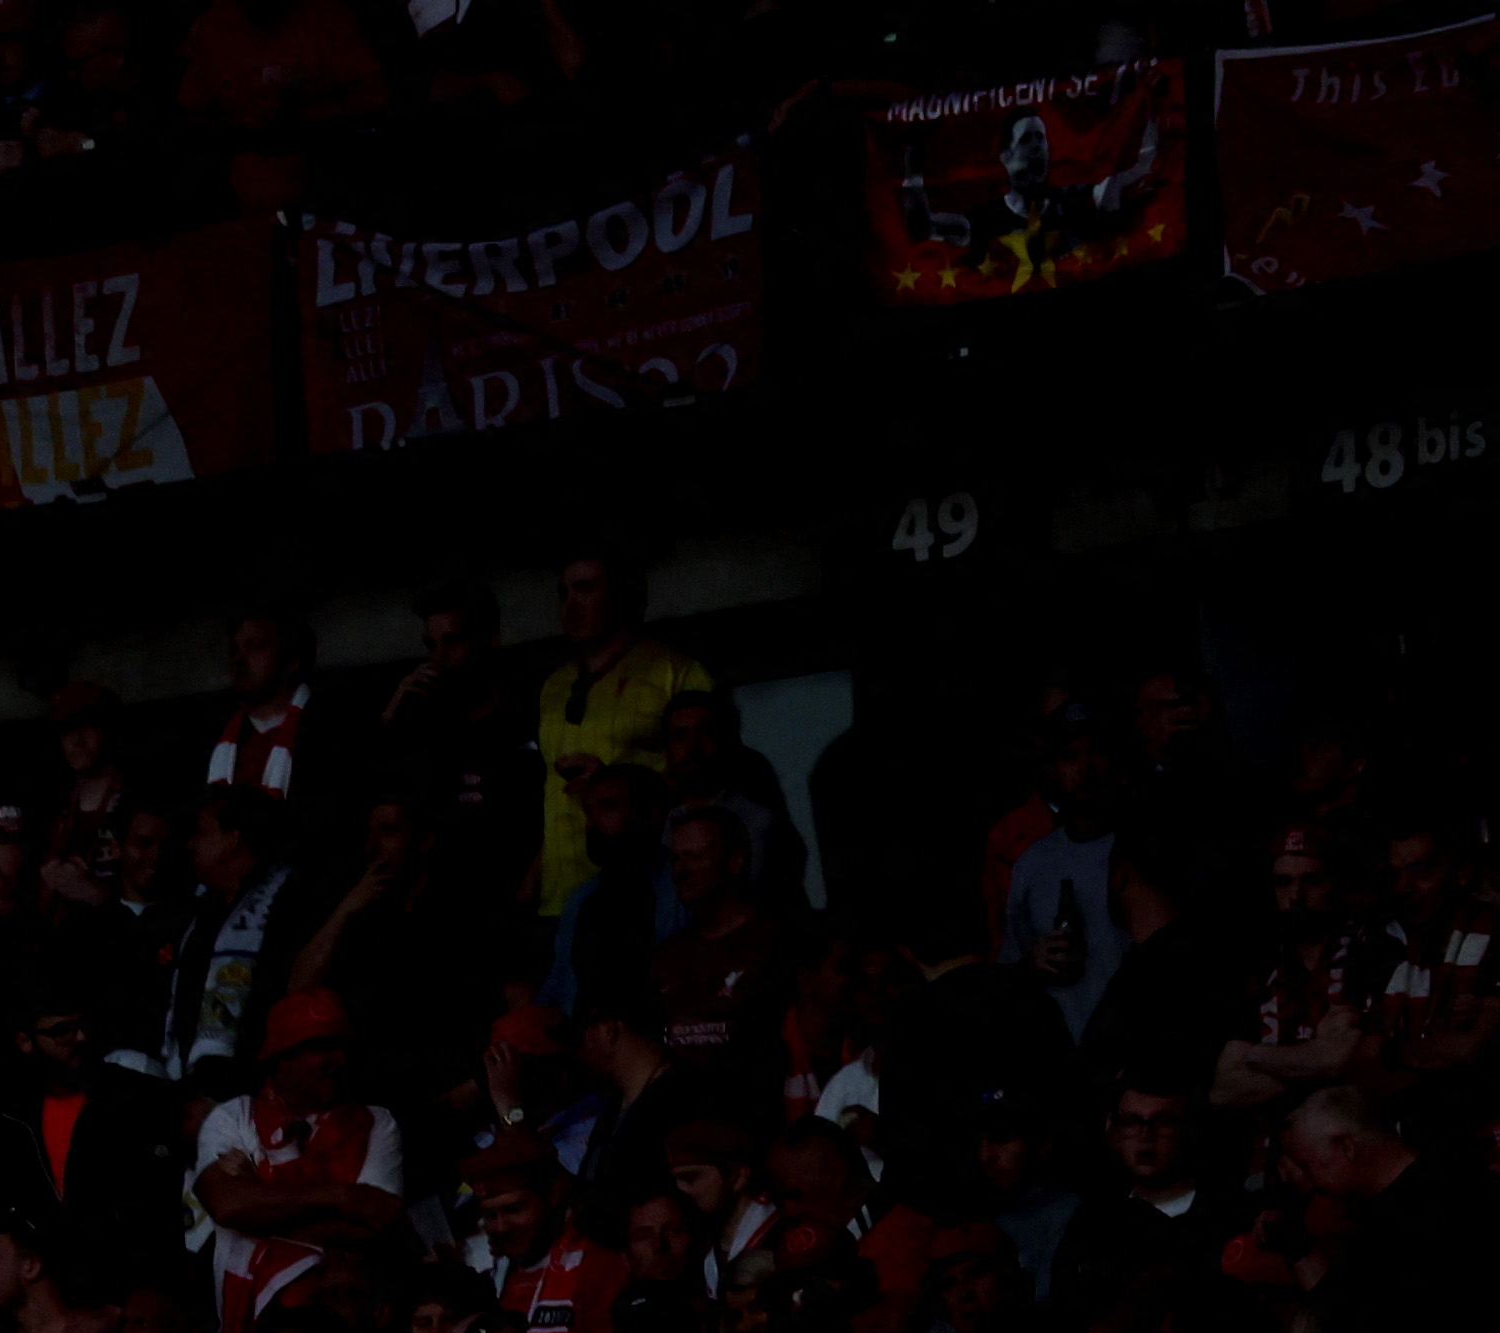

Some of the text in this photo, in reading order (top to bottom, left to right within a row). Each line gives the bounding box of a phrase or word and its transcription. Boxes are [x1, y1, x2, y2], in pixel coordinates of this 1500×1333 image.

[315, 163, 754, 308] LIVERPOOL
[1320, 410, 1487, 494] 48 bis
[891, 491, 980, 562] 49
